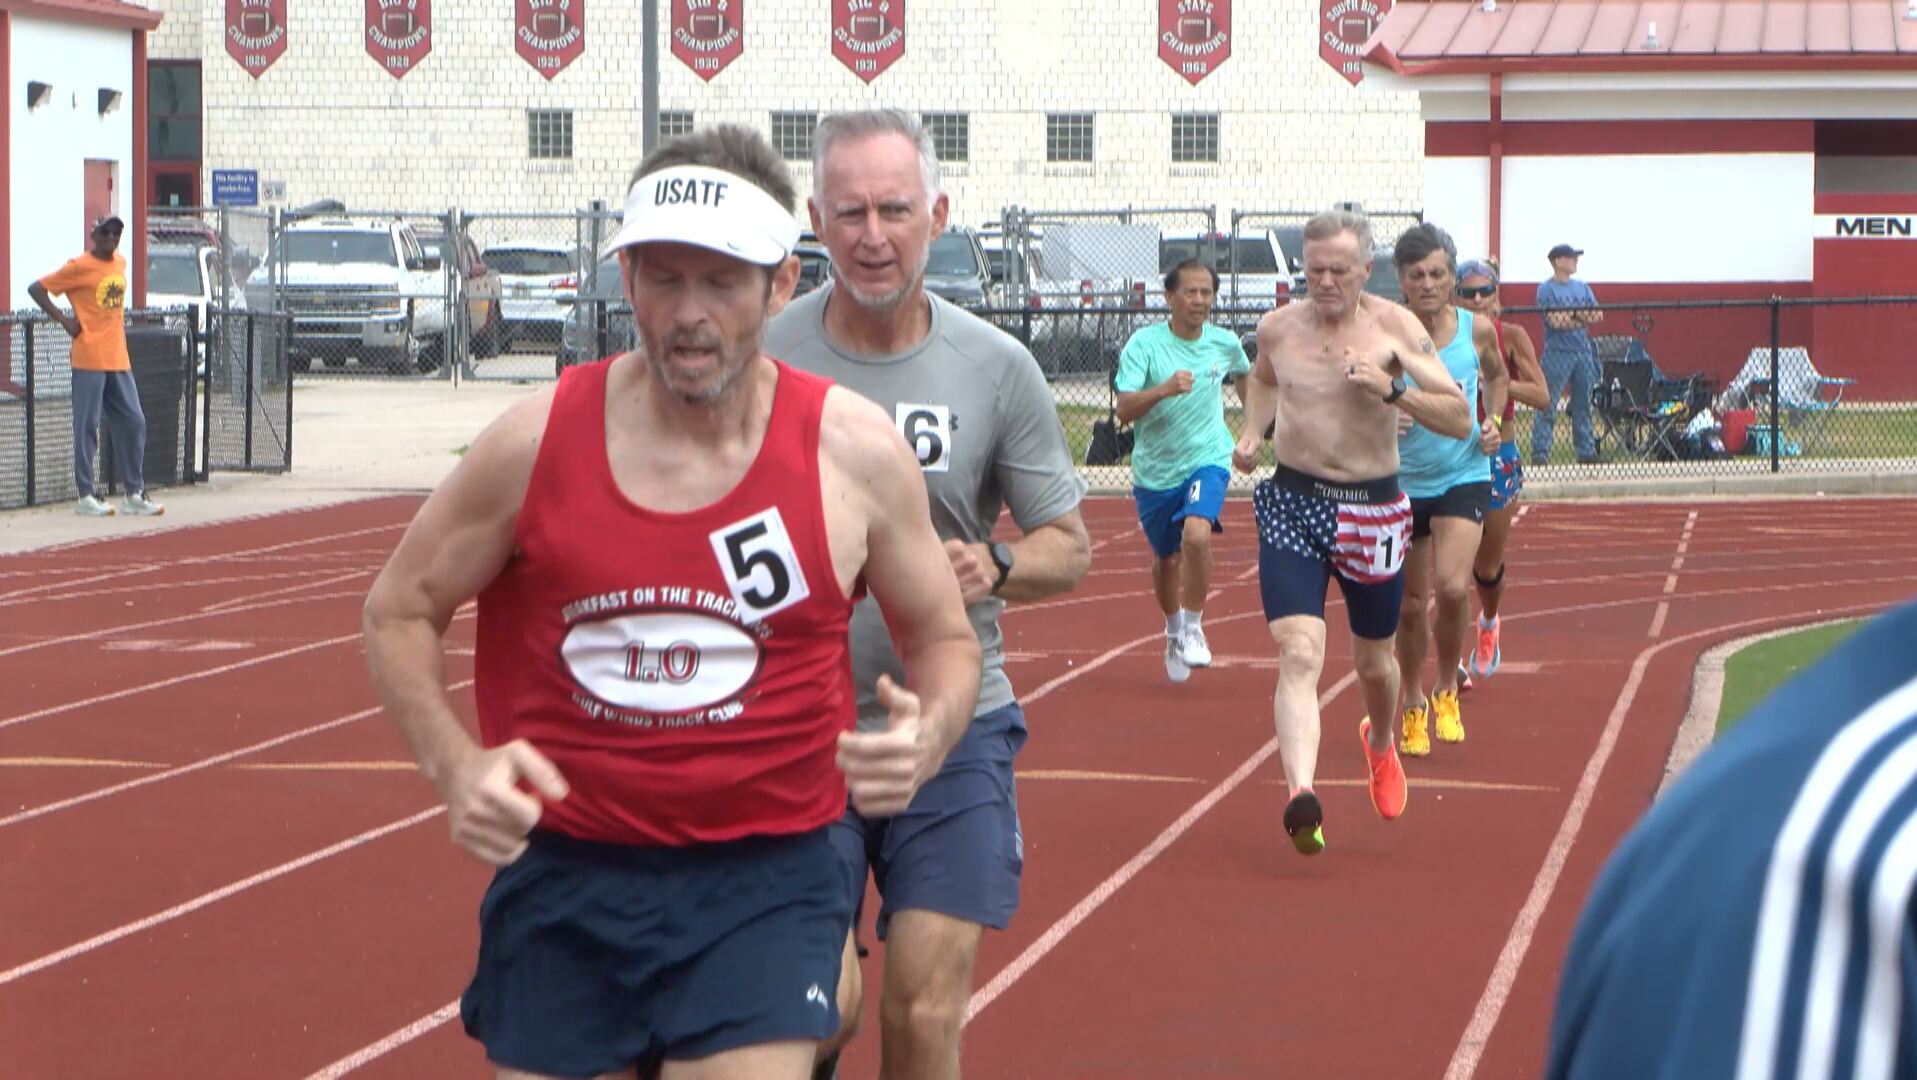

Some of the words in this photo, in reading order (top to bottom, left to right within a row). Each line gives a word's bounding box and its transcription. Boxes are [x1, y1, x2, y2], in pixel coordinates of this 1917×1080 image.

[1177, 0, 1214, 14] STATE
[1326, 0, 1358, 22] SOUTH
[1361, 0, 1378, 16] BIG
[228, 24, 284, 49] CHAMPIONS
[368, 24, 428, 50] CHAMPIONS
[518, 24, 581, 51] CHAMPIONS
[674, 26, 739, 52] CHAMPIONS
[1162, 31, 1228, 56] CHAMPIONS
[1343, 61, 1361, 74] 196
[654, 178, 729, 208] USATF
[1836, 217, 1911, 235] MEN
[904, 410, 943, 467] 6
[724, 519, 790, 610] 5
[1380, 535, 1394, 569] 1
[633, 586, 655, 605] ON
[660, 585, 691, 605] THE
[625, 639, 701, 685] 1.0
[658, 711, 704, 728] TRACK
[708, 700, 744, 723] CLUB
